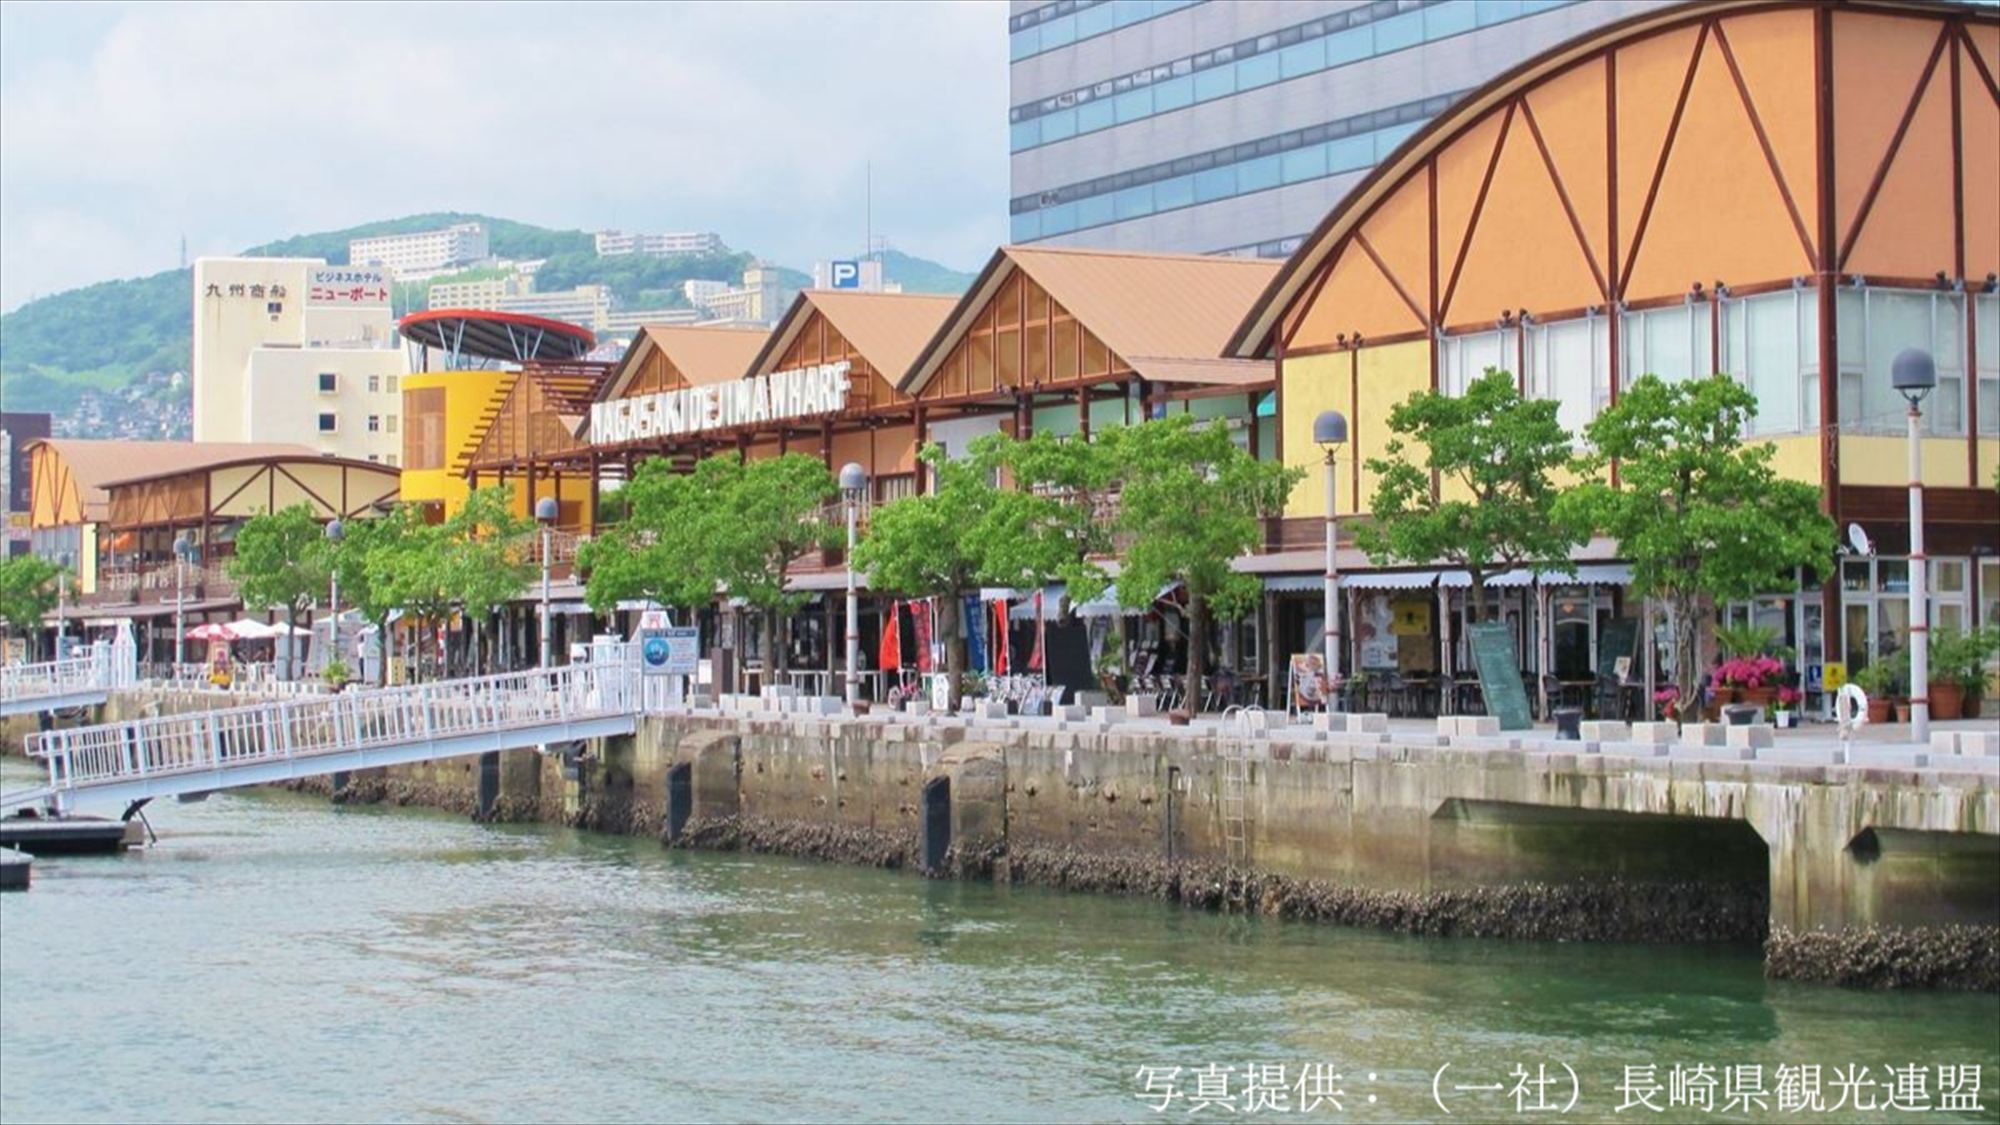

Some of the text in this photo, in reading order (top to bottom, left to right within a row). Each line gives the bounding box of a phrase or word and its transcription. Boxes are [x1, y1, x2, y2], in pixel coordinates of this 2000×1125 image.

[316, 271, 382, 283] ビジネスホテル
[834, 264, 856, 285] P
[206, 283, 287, 299] 九州商船
[591, 361, 852, 446] NAGASAKI DEJIMA WHARF
